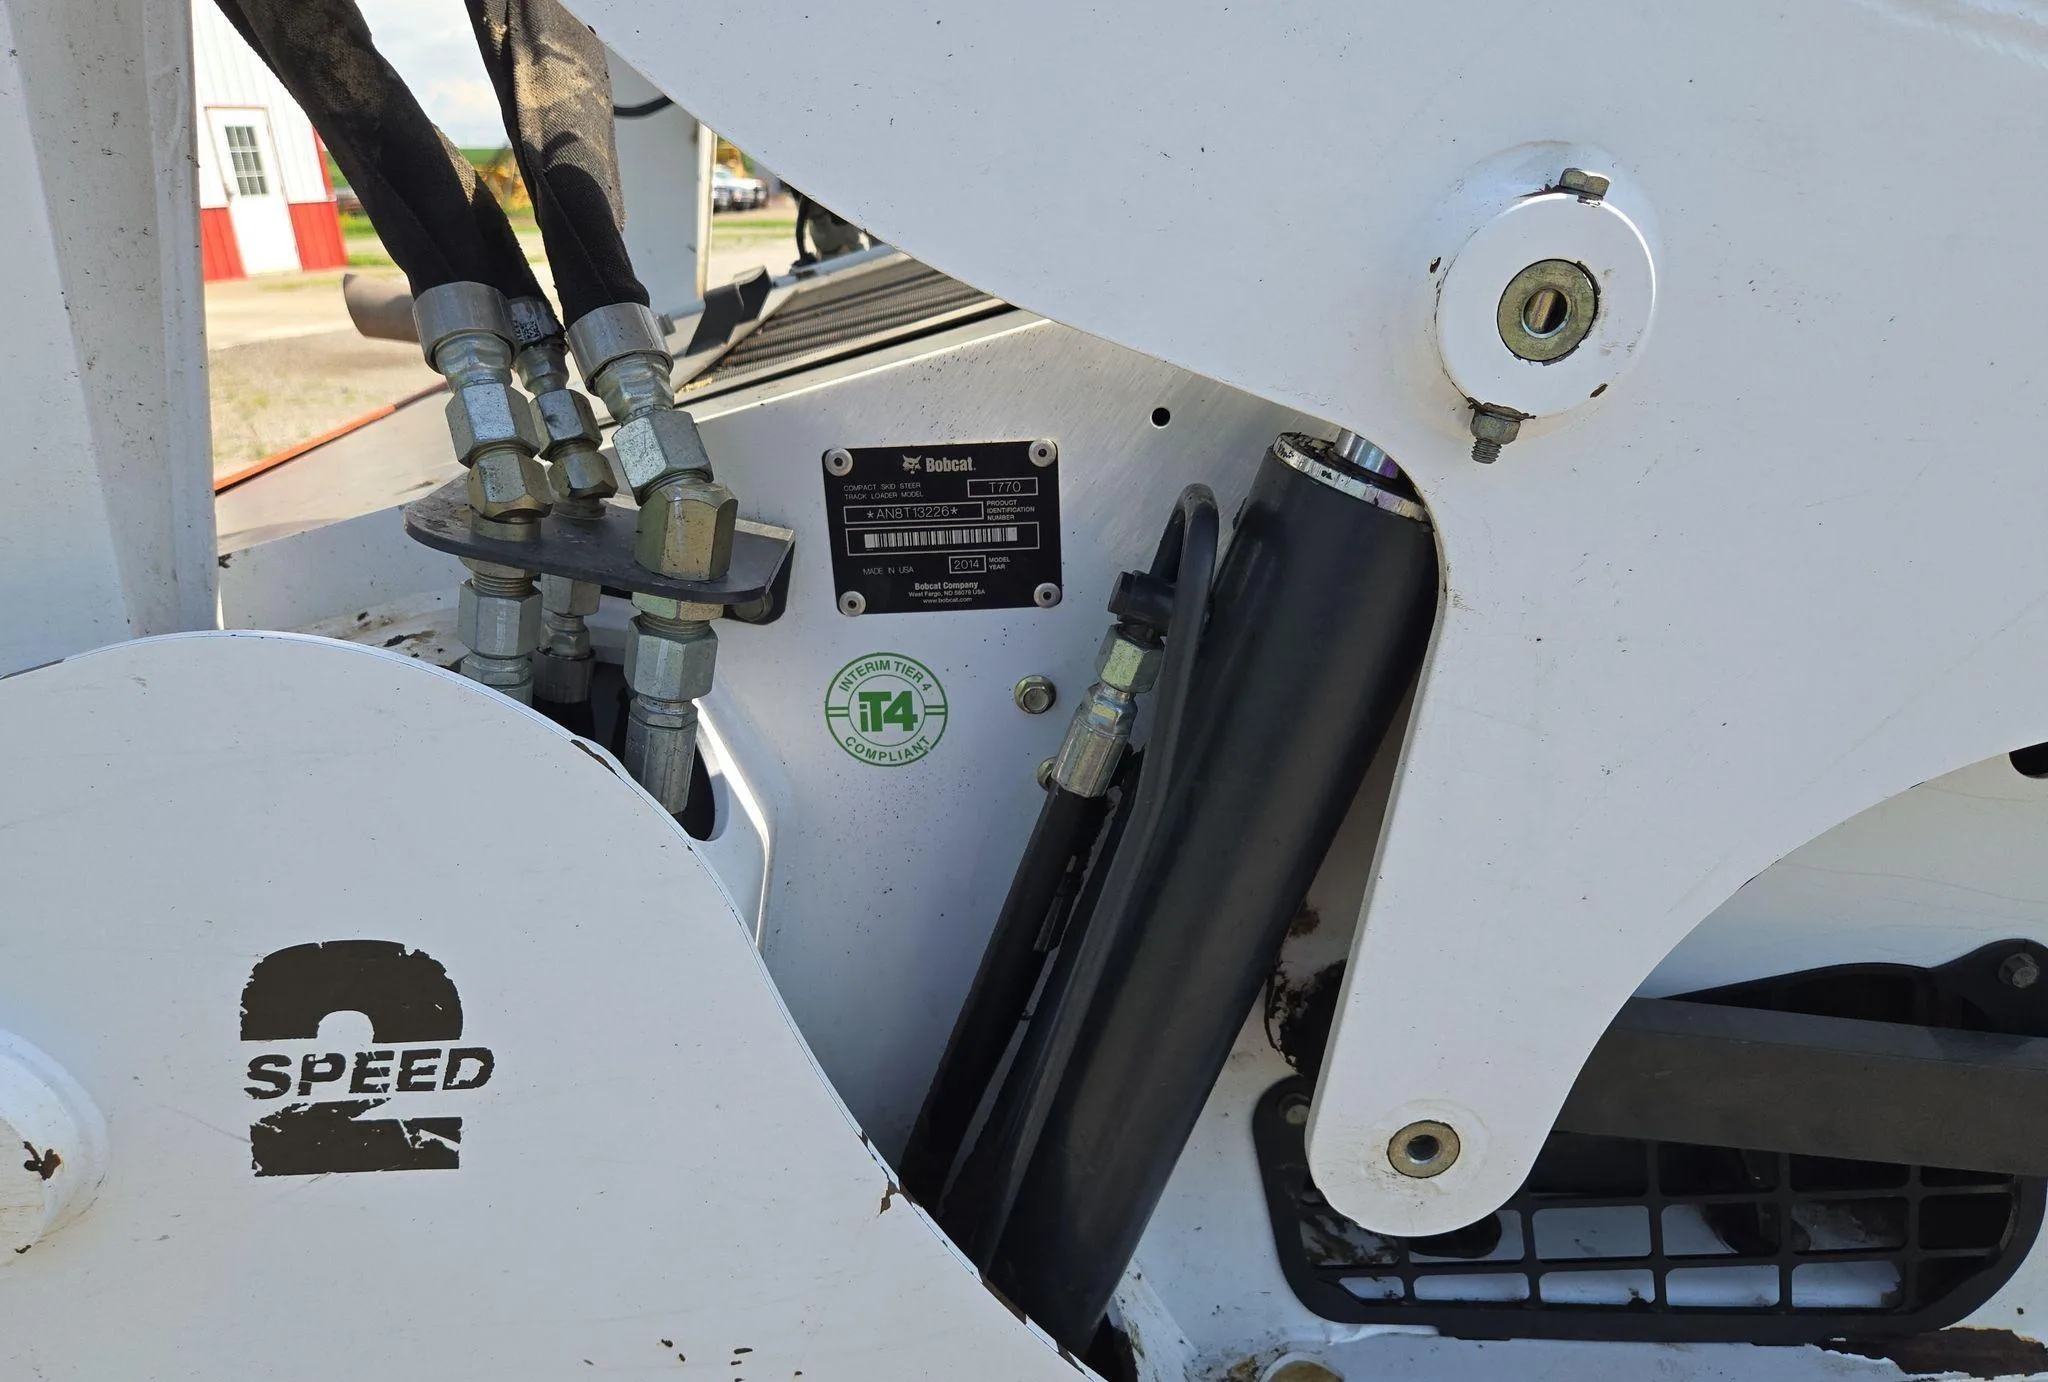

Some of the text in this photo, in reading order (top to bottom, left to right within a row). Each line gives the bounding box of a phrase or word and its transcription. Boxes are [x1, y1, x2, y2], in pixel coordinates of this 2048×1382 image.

[925, 457, 974, 473] Bobcat
[843, 482, 921, 492] COMPACT SKID STEER
[988, 481, 1021, 493] T770
[844, 491, 924, 501] TRACK LOADER MODEL
[986, 499, 1018, 507] PRODUCT
[986, 506, 1035, 514] IDENTIFICATION
[863, 567, 884, 575] MADE
[898, 565, 915, 574] USA
[954, 559, 980, 570] 2014
[914, 581, 979, 591] Bobcat Company
[943, 589, 954, 597] ND
[972, 588, 986, 596] USA
[839, 659, 932, 692] INTERIM TIER 4
[859, 691, 918, 733] iT4
[845, 735, 930, 761] COMPLIANT
[240, 940, 463, 1177] 2
[243, 1047, 495, 1100] SPEED
